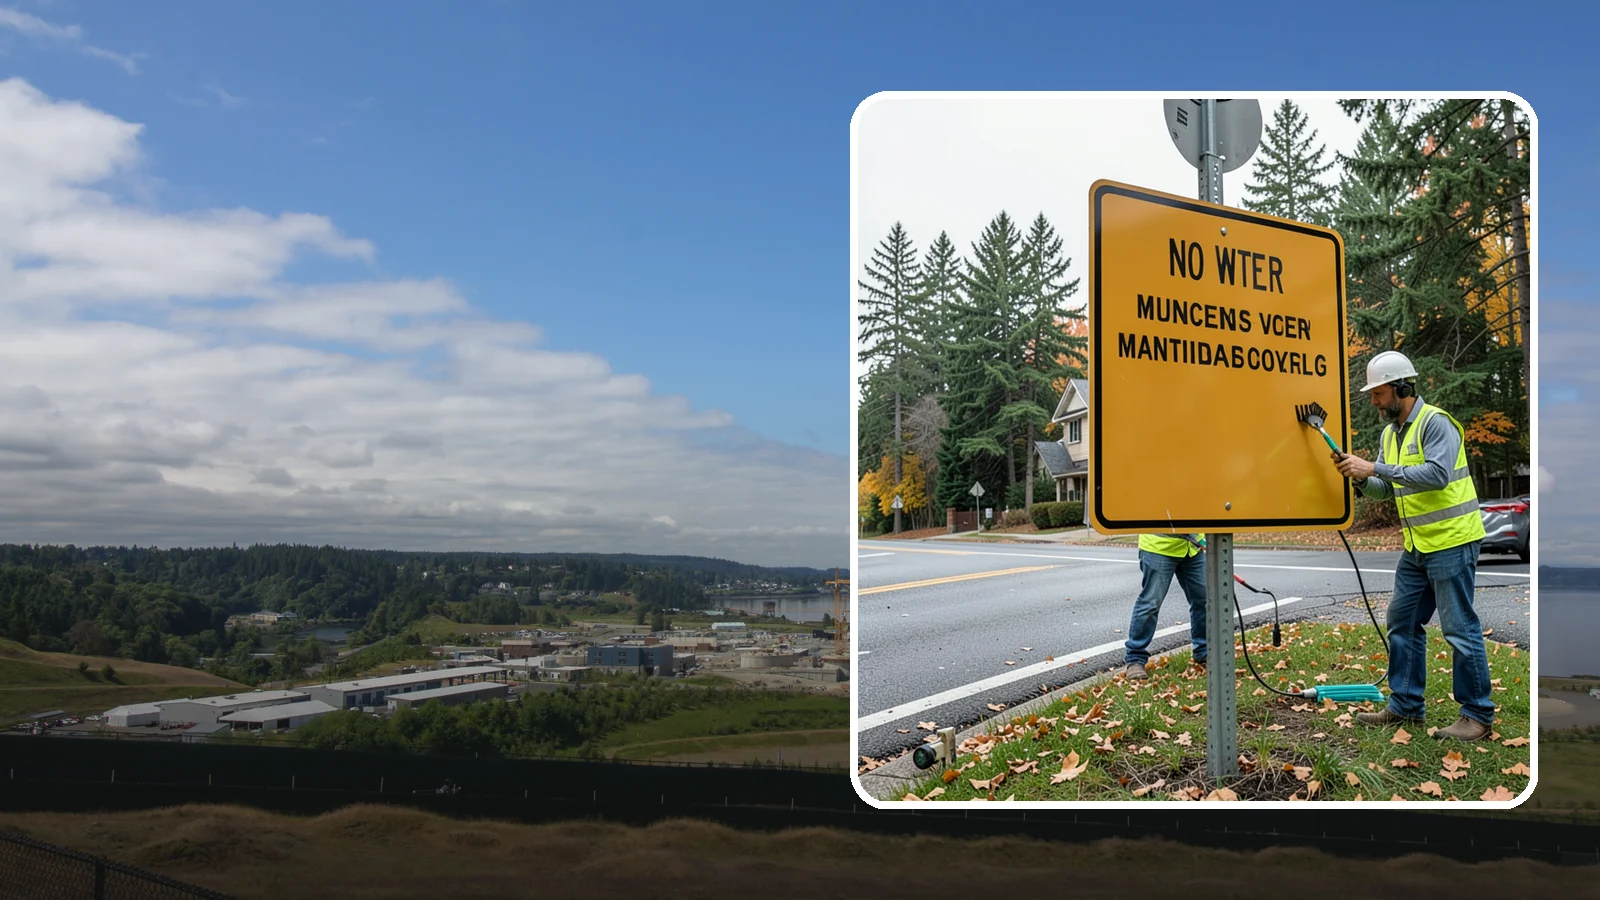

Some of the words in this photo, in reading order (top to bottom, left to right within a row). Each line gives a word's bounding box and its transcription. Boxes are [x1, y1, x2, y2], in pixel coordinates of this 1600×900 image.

[1169, 237, 1204, 281] NO
[1214, 245, 1284, 295] WTER
[1136, 293, 1252, 333] MUNCENS
